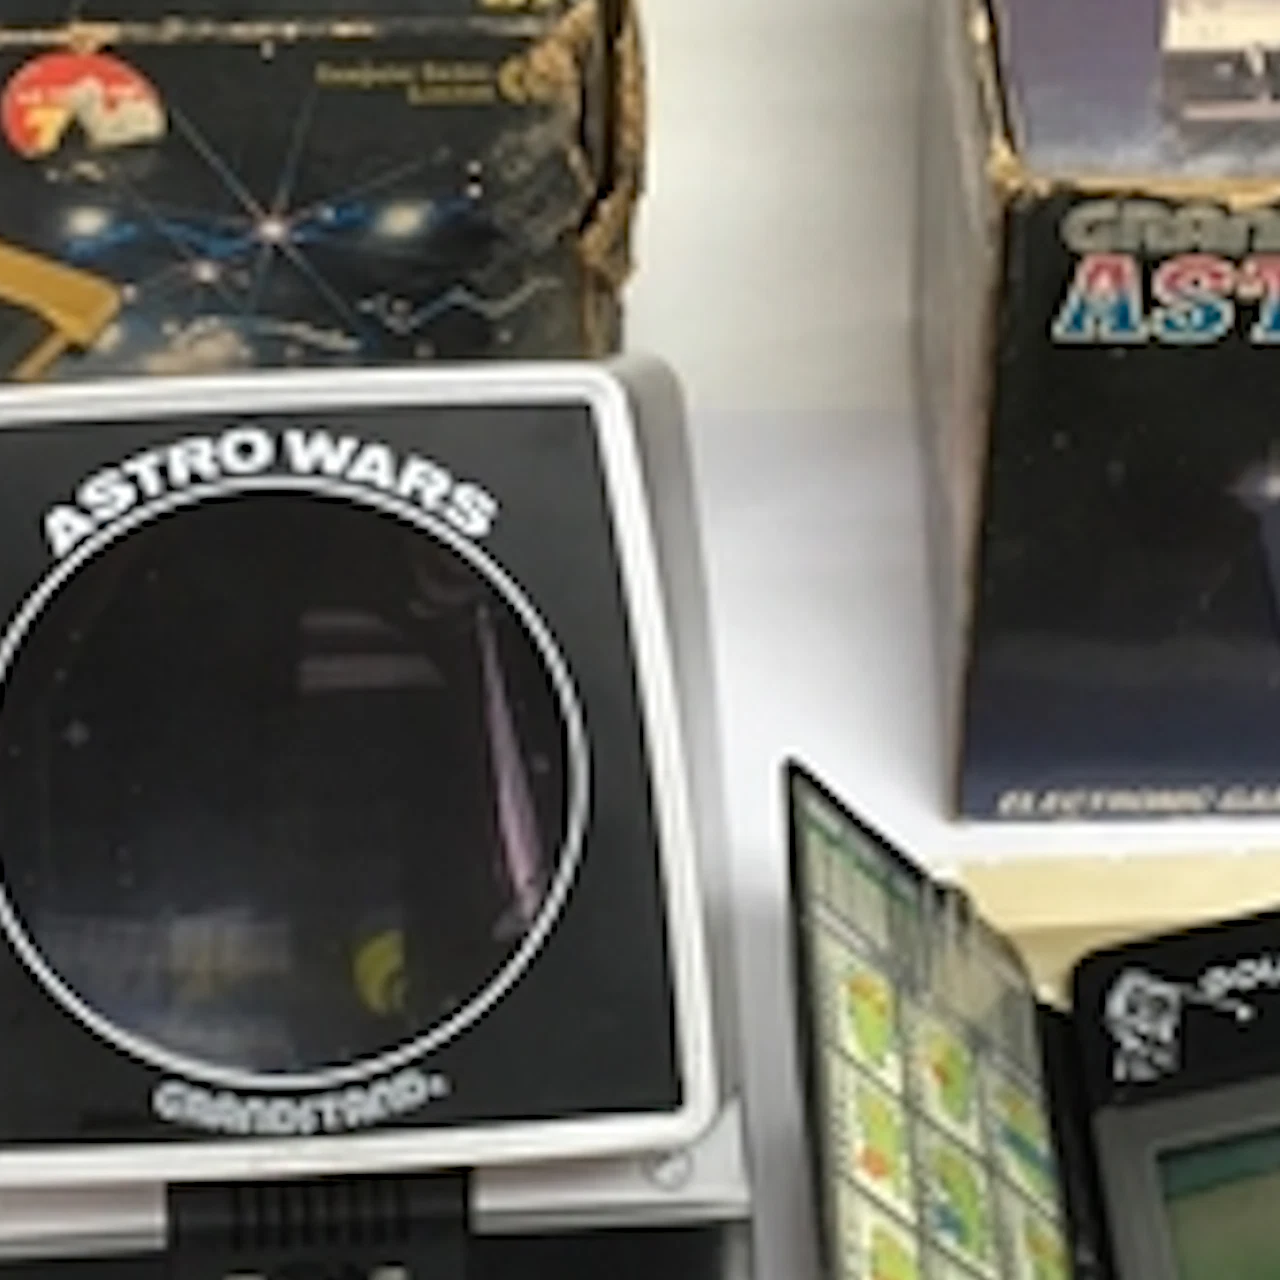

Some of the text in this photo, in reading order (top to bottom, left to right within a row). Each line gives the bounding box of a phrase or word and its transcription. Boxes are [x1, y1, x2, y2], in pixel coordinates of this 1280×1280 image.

[43, 427, 499, 557] ASTRO WARS
[152, 1069, 430, 1134] GRANDSTAND
